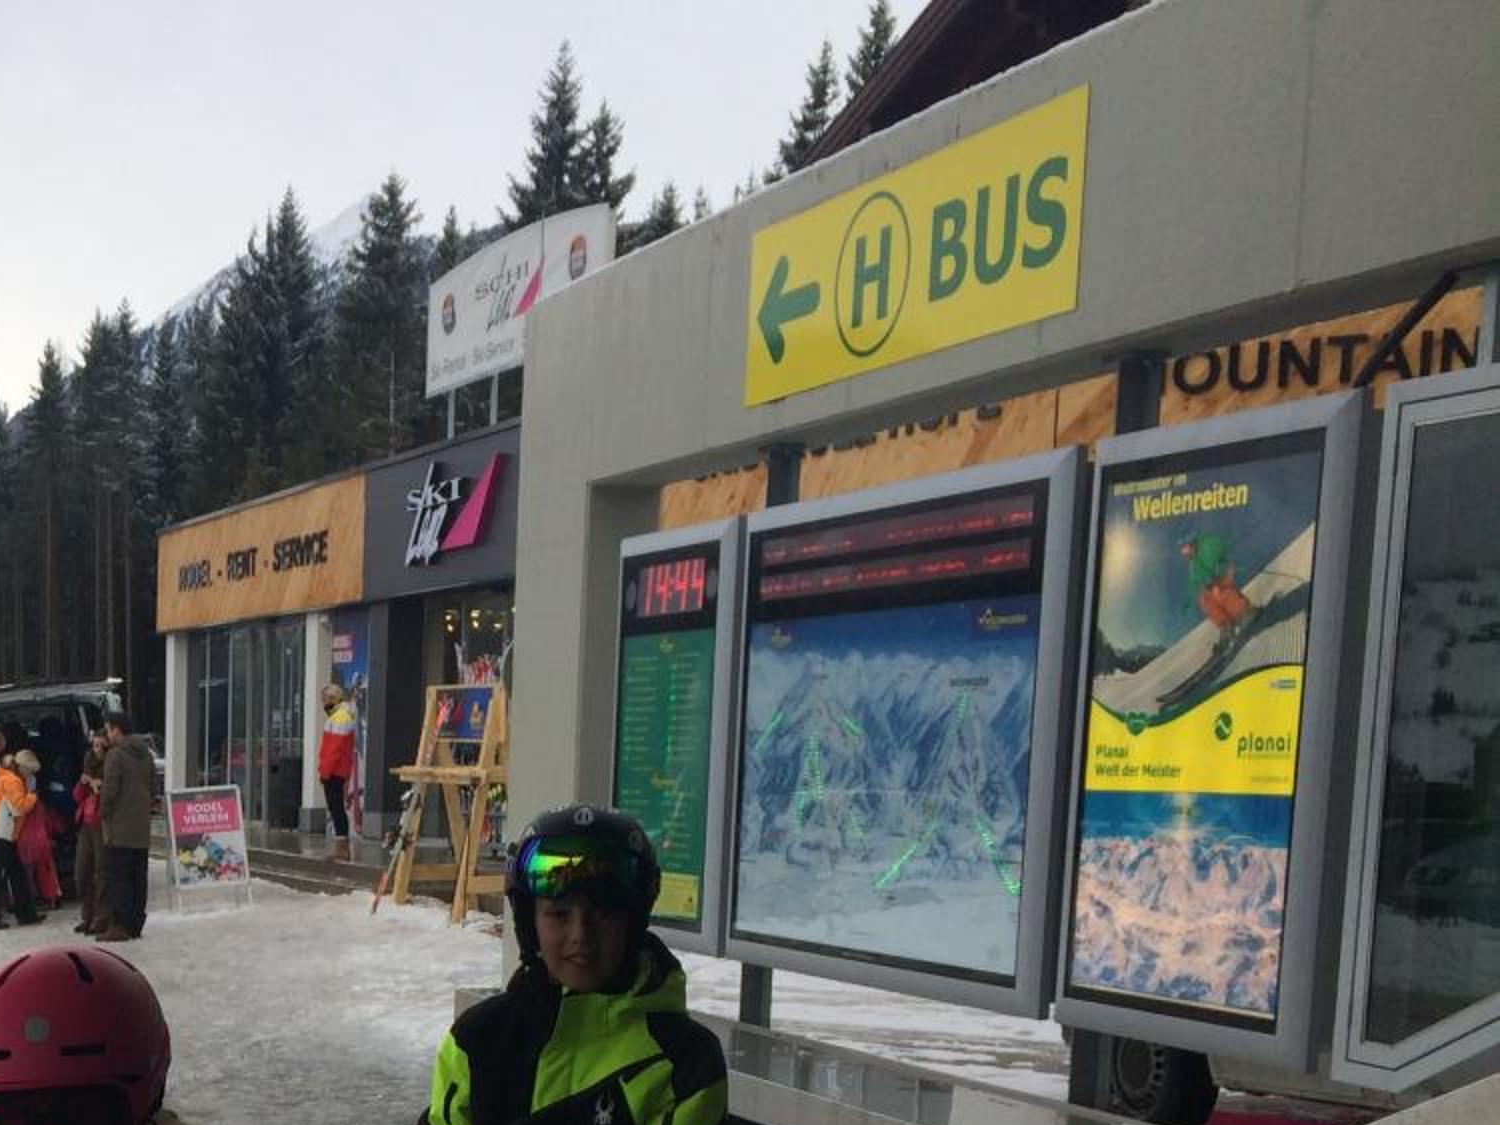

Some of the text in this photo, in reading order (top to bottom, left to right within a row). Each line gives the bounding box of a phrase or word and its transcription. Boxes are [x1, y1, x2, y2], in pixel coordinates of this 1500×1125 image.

[852, 156, 1068, 328] H BUS
[1162, 326, 1480, 394] OUNTAIN
[1133, 482, 1248, 521] Wellenreiten
[227, 546, 257, 582] RENT
[272, 529, 329, 573] SERVICE
[1095, 744, 1129, 758] Planai
[1237, 731, 1292, 758] planai
[1095, 763, 1182, 777] Welt der Meister
[186, 801, 224, 814] RODEL
